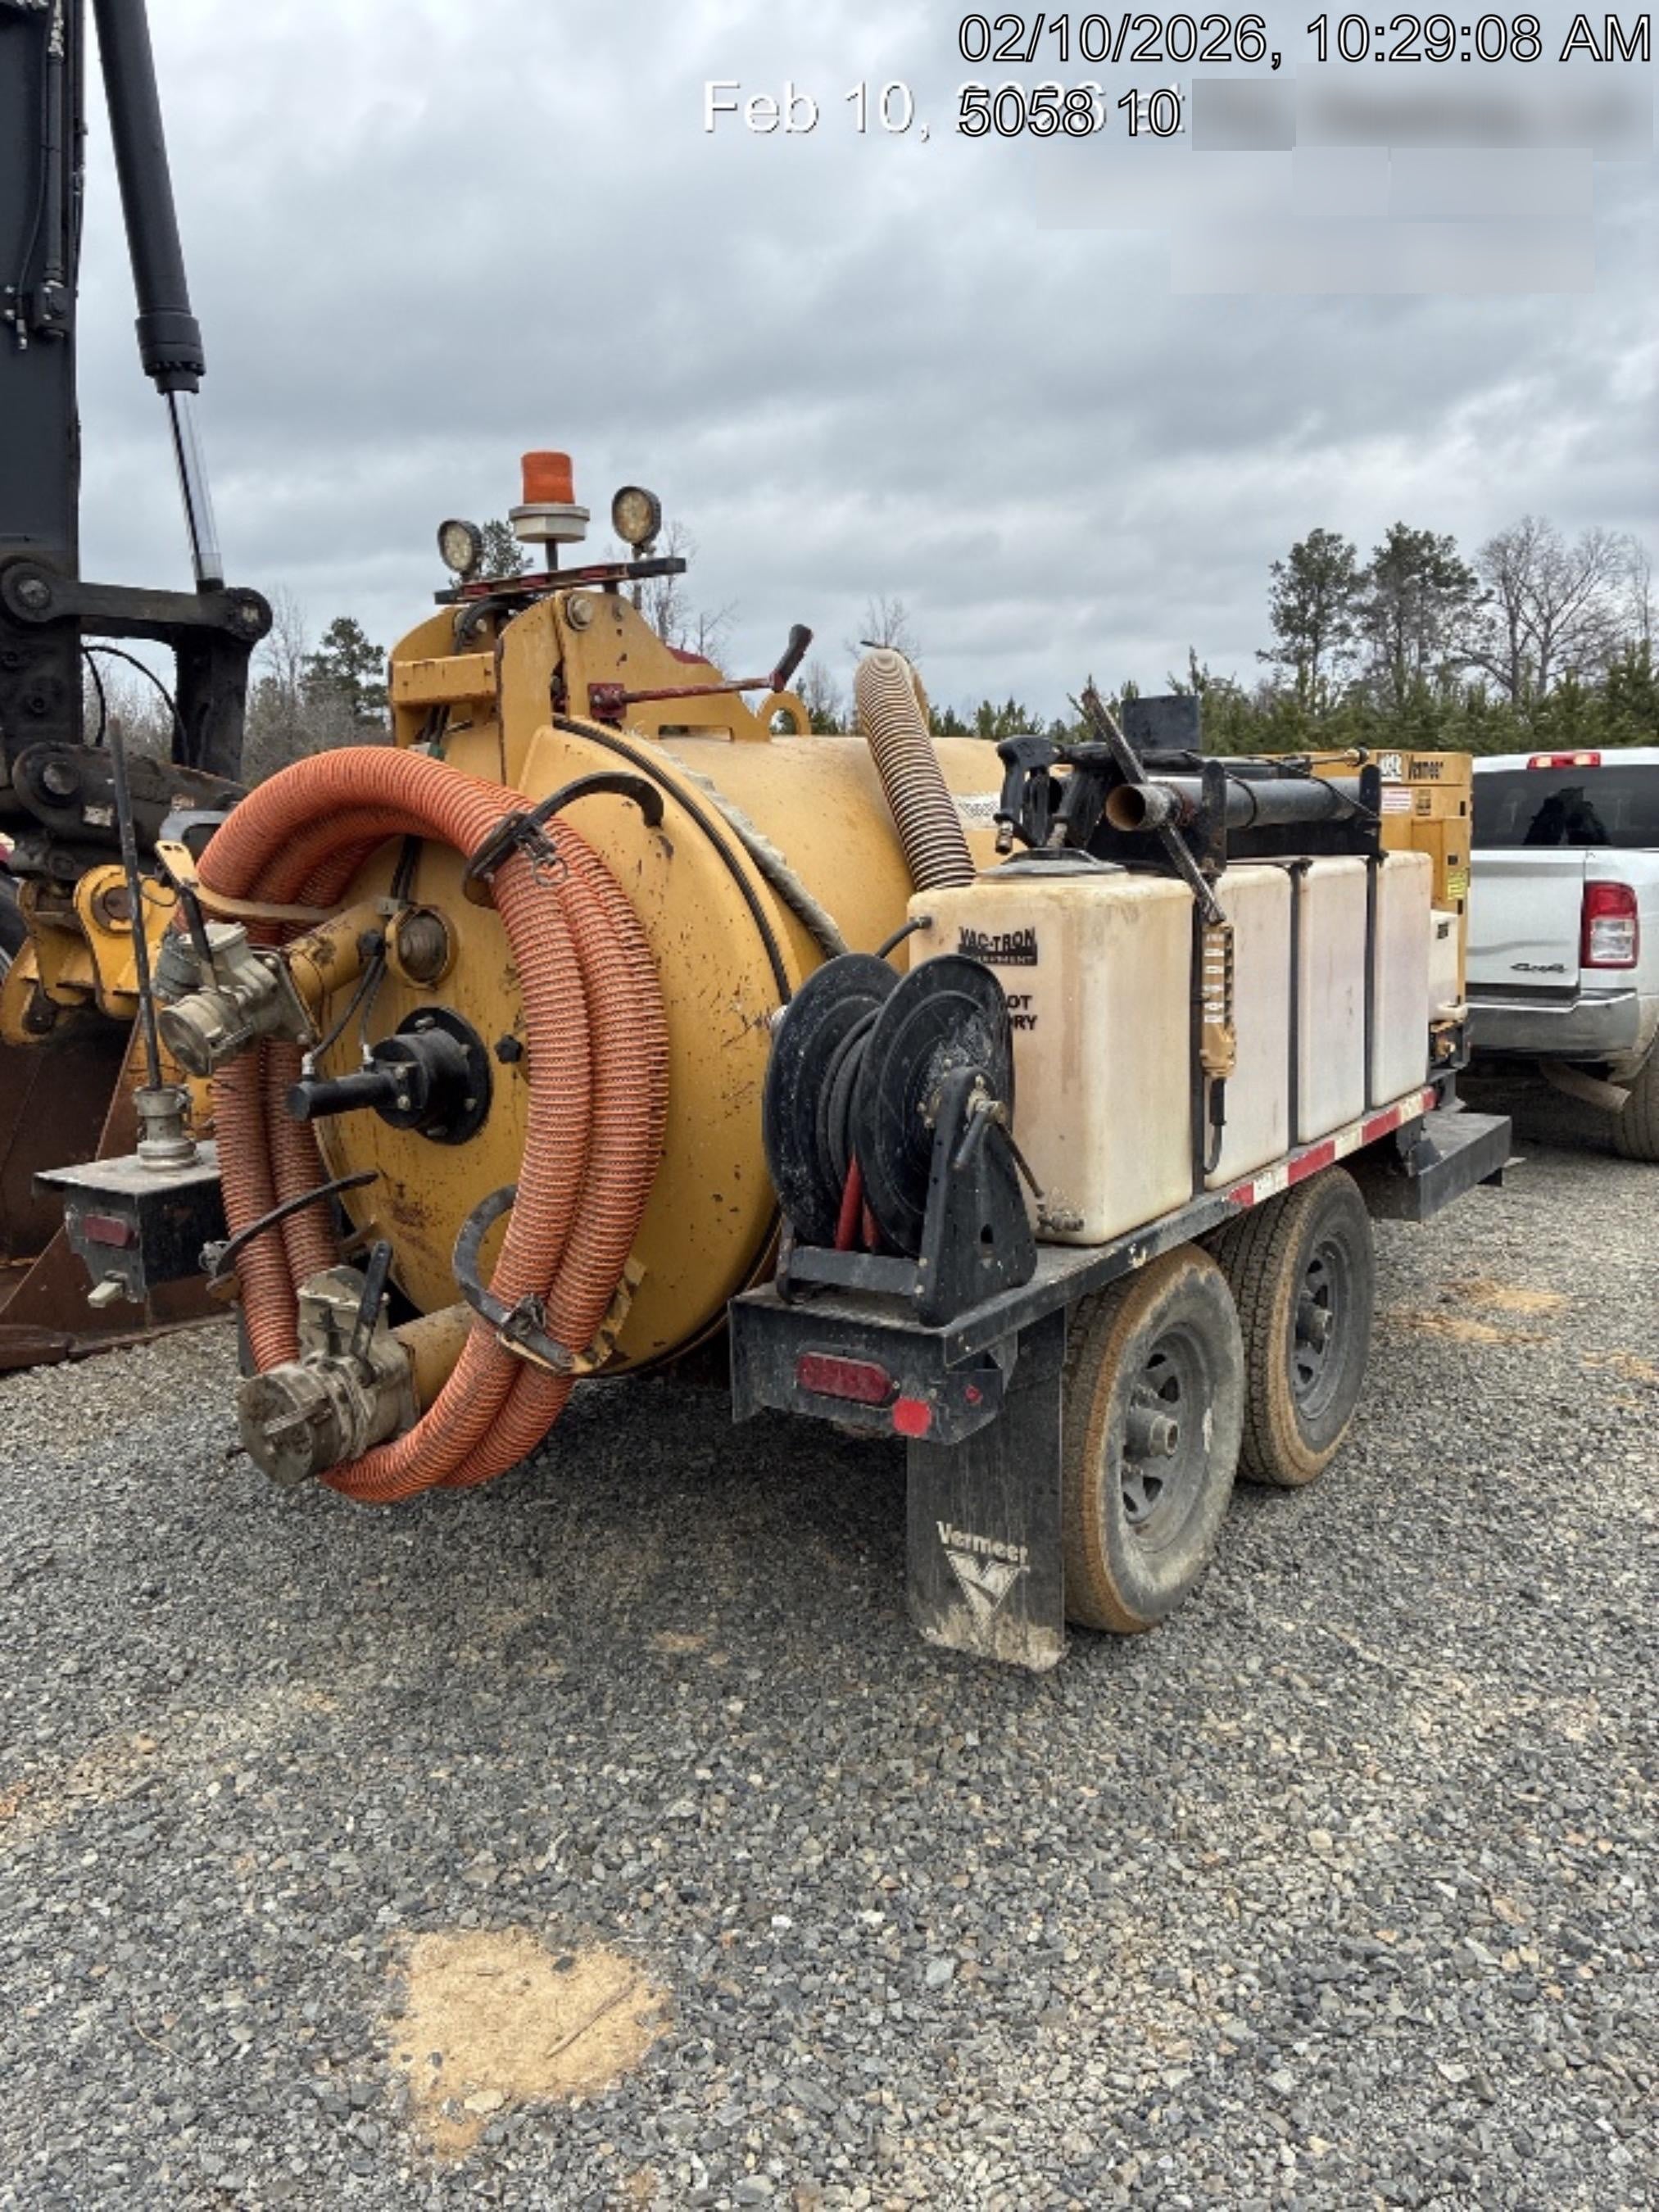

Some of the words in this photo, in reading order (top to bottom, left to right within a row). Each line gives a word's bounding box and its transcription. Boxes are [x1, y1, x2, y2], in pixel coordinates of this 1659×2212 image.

[1004, 995, 1033, 1010] OT
[1010, 1015, 1038, 1030] RY
[936, 1521, 1029, 1564] Vermeer
